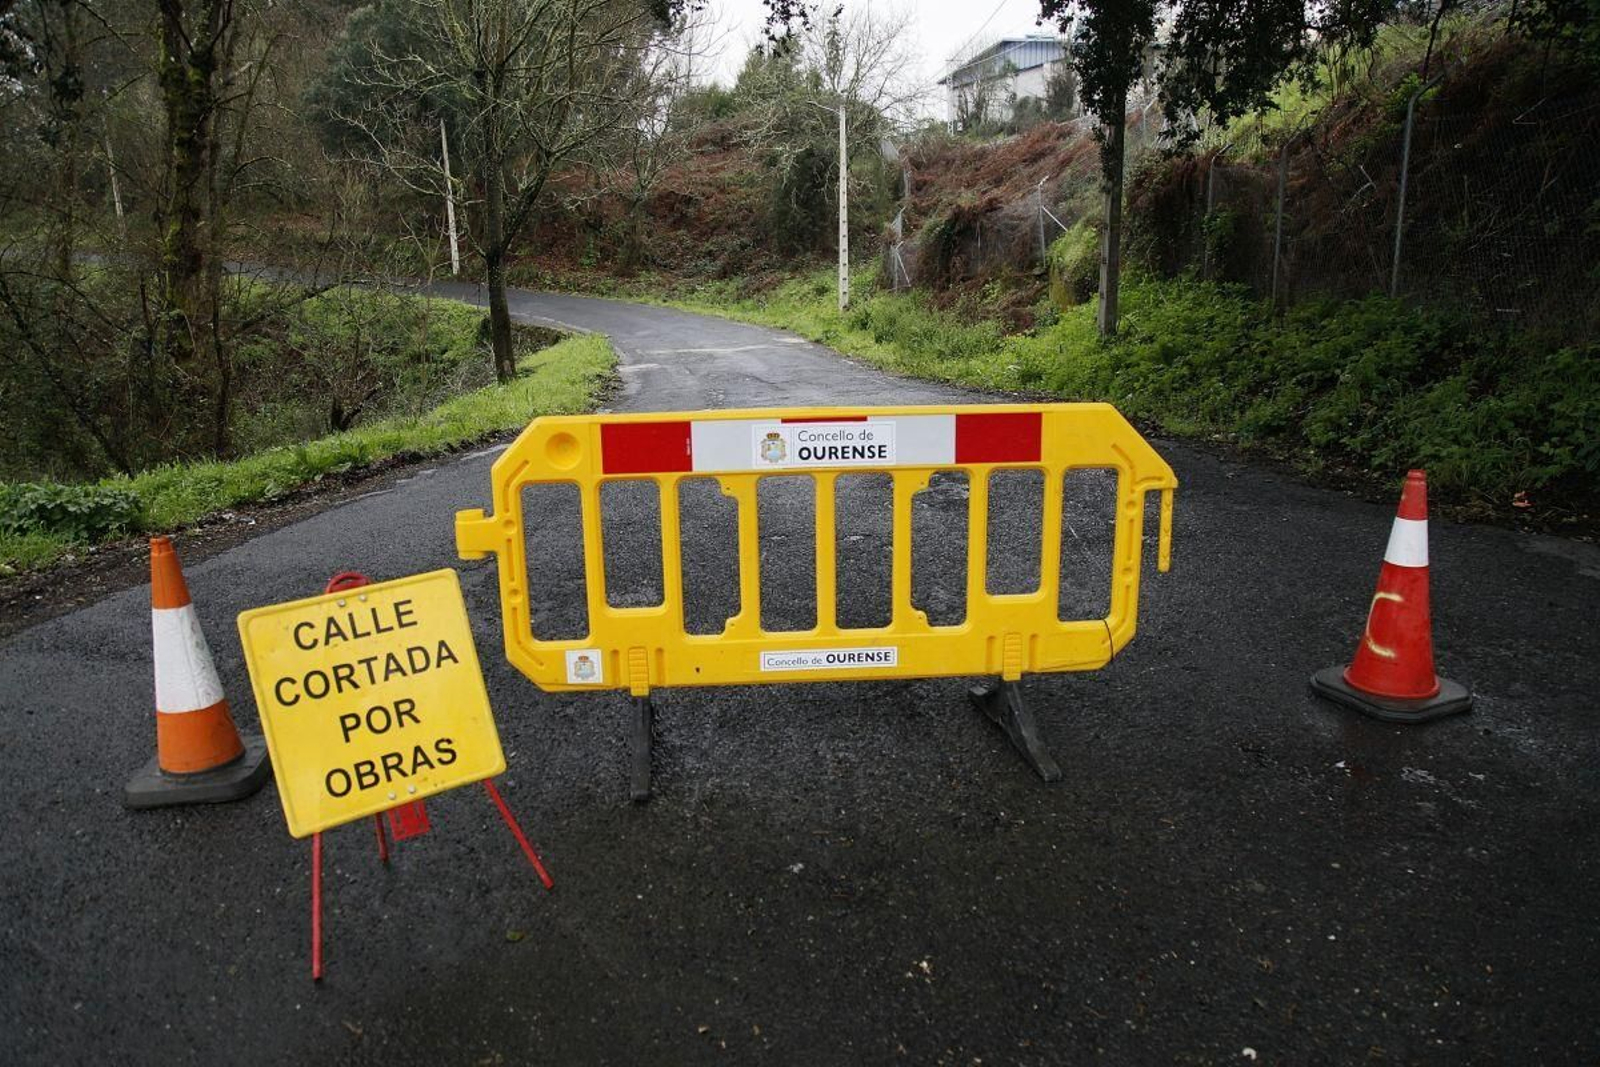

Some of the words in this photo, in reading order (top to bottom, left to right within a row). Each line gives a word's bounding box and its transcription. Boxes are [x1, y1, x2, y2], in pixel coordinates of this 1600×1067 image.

[798, 430, 854, 442] Concello
[858, 429, 874, 441] de
[798, 445, 887, 460] OURENSE
[294, 600, 418, 650] CALLE
[275, 640, 459, 706] CORTADA
[767, 657, 808, 667] Concello
[811, 656, 823, 665] de
[826, 651, 891, 664] OURENSE
[339, 698, 420, 743] POR
[325, 738, 457, 797] OBRAS
